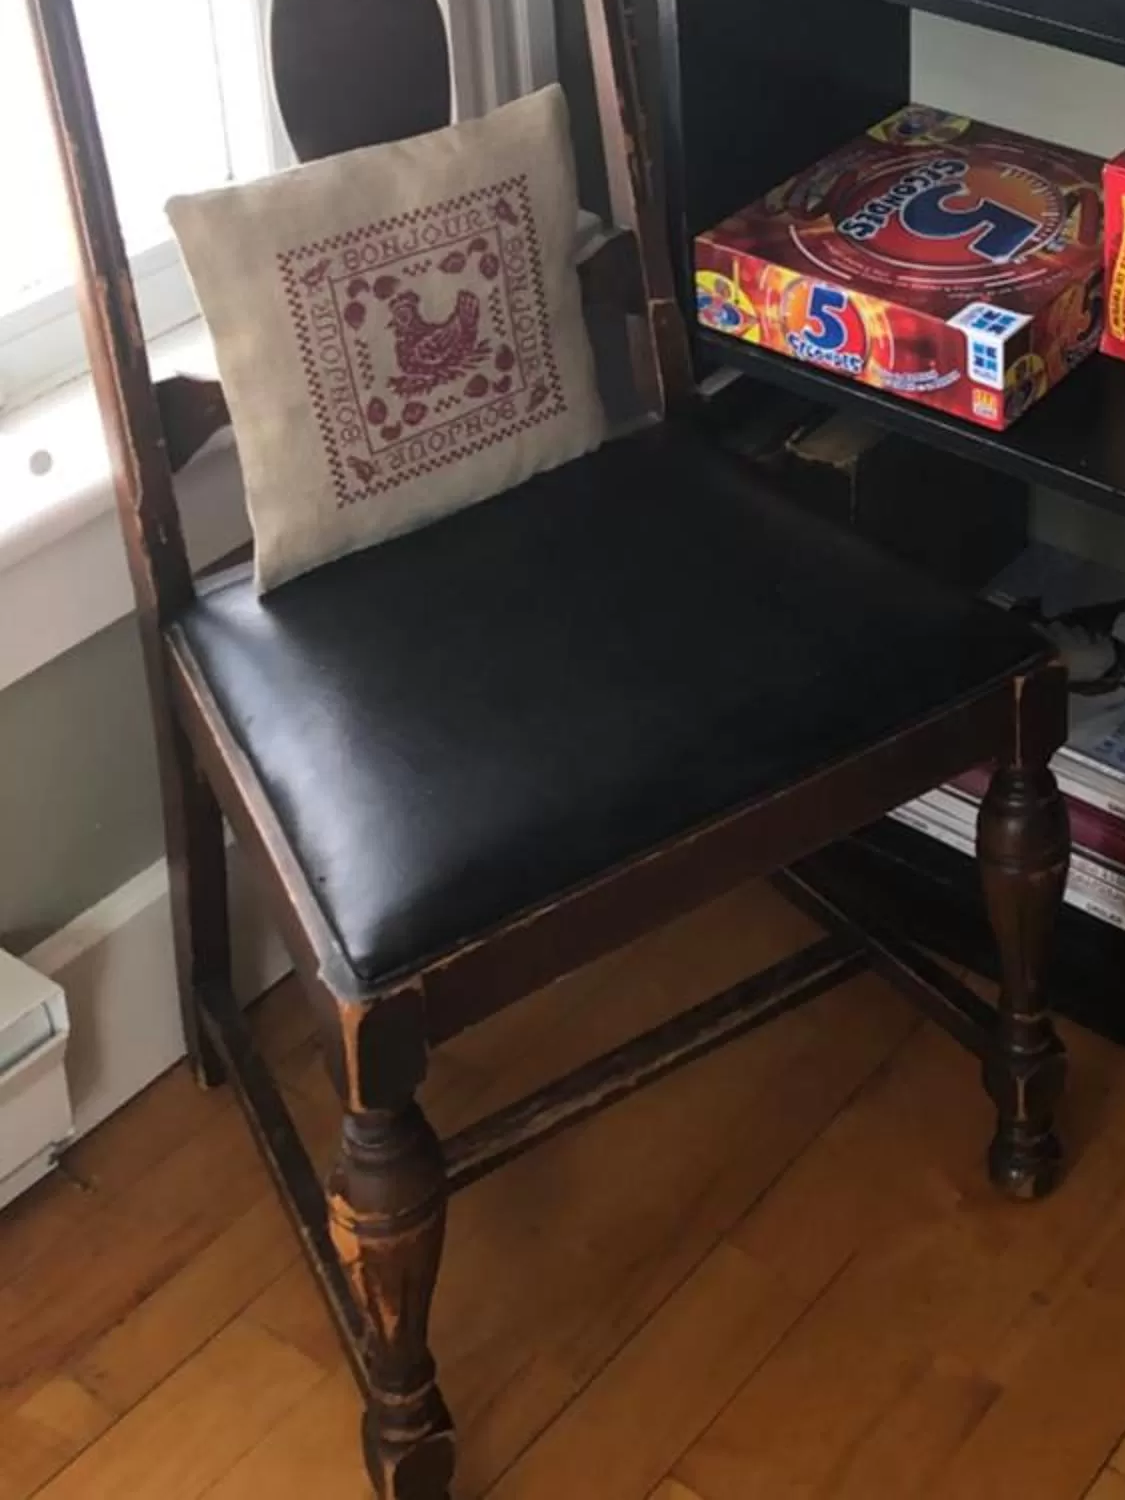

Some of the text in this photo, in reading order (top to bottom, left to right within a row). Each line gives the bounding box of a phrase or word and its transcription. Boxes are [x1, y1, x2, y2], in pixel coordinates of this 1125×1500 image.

[343, 211, 486, 273] BONJOUR
[902, 182, 1041, 262] 5
[803, 285, 849, 349] 5
